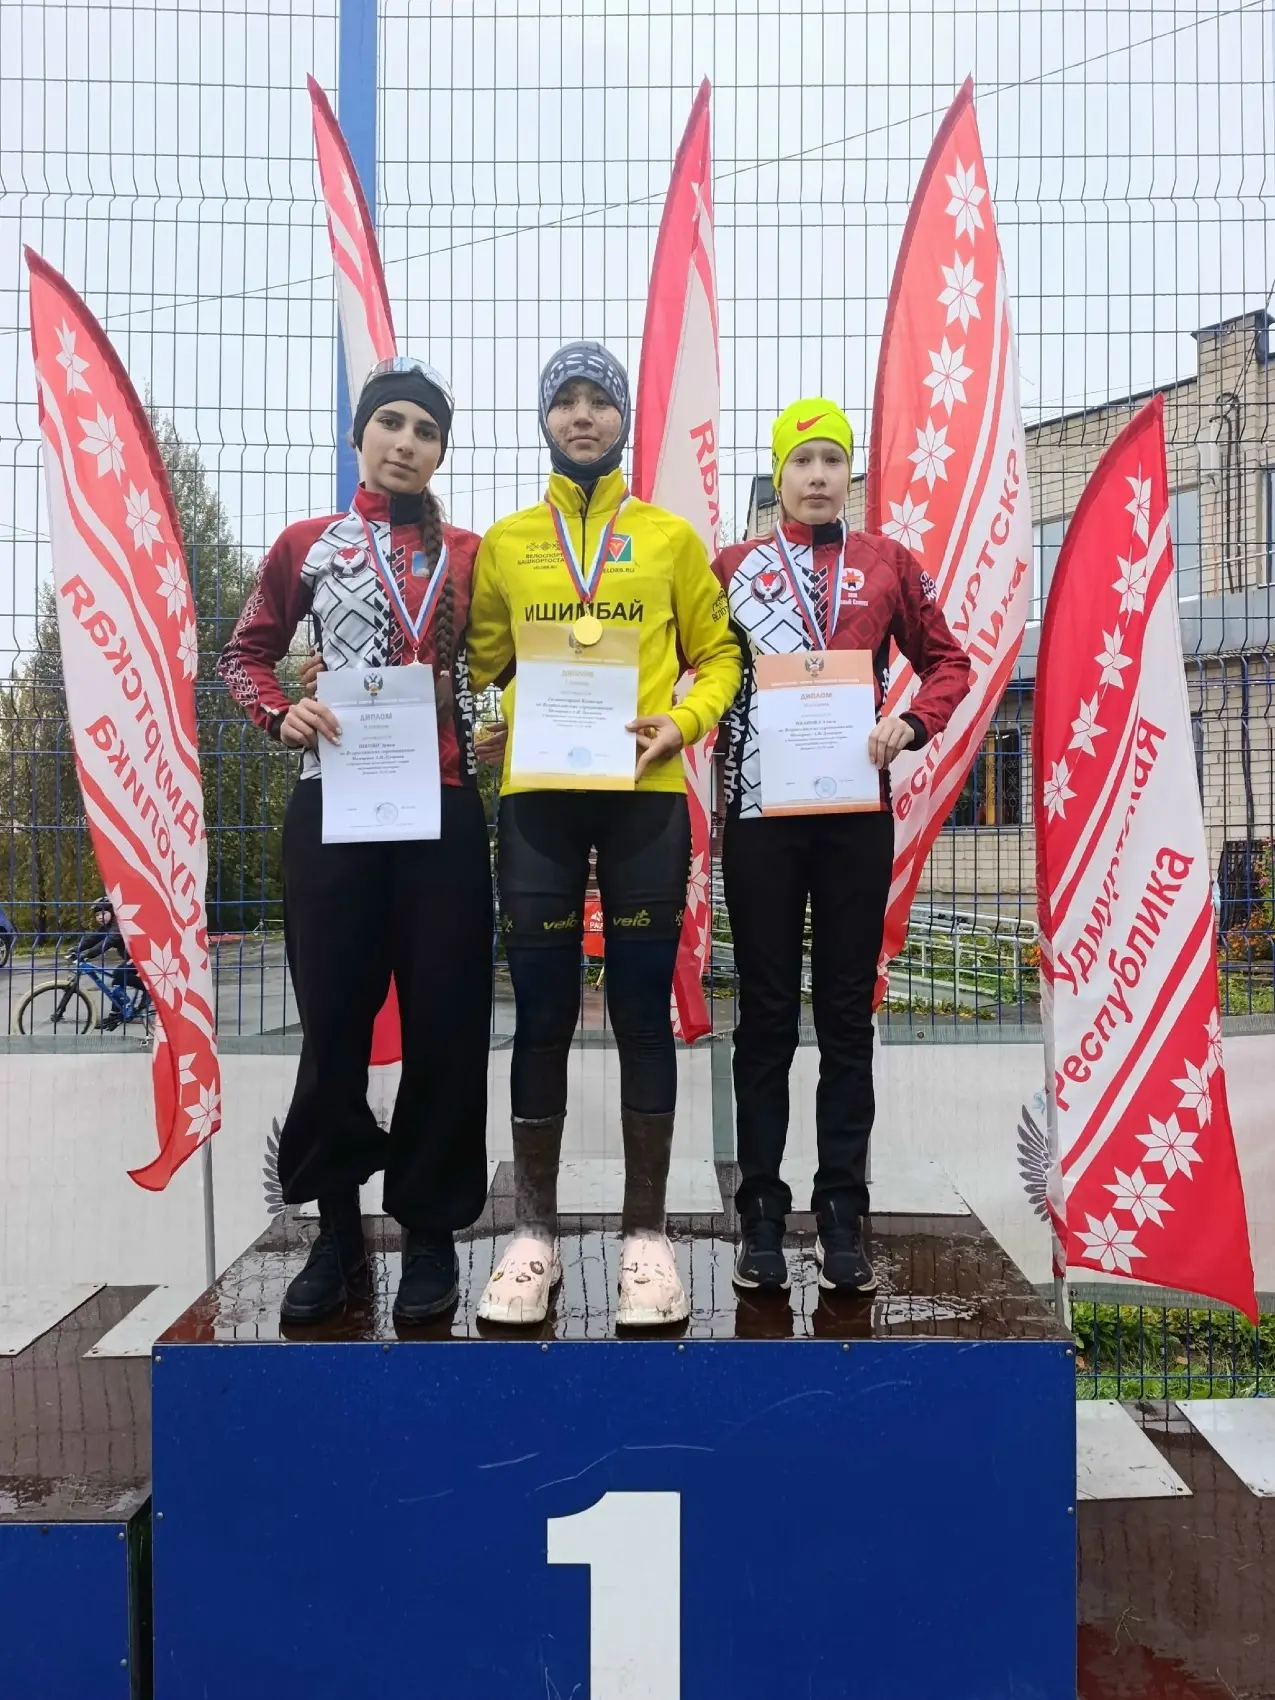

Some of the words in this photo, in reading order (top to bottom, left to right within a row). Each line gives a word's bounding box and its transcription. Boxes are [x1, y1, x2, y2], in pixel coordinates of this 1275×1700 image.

[517, 557, 565, 566] БАШКОРТОСТА
[525, 599, 644, 623] ИШИМБАЙ
[800, 692, 833, 701] ДИПЛОМ
[360, 712, 393, 722] ДИПЛОМ
[1054, 847, 1195, 1112] Республика
[547, 1491, 681, 1700] 1
